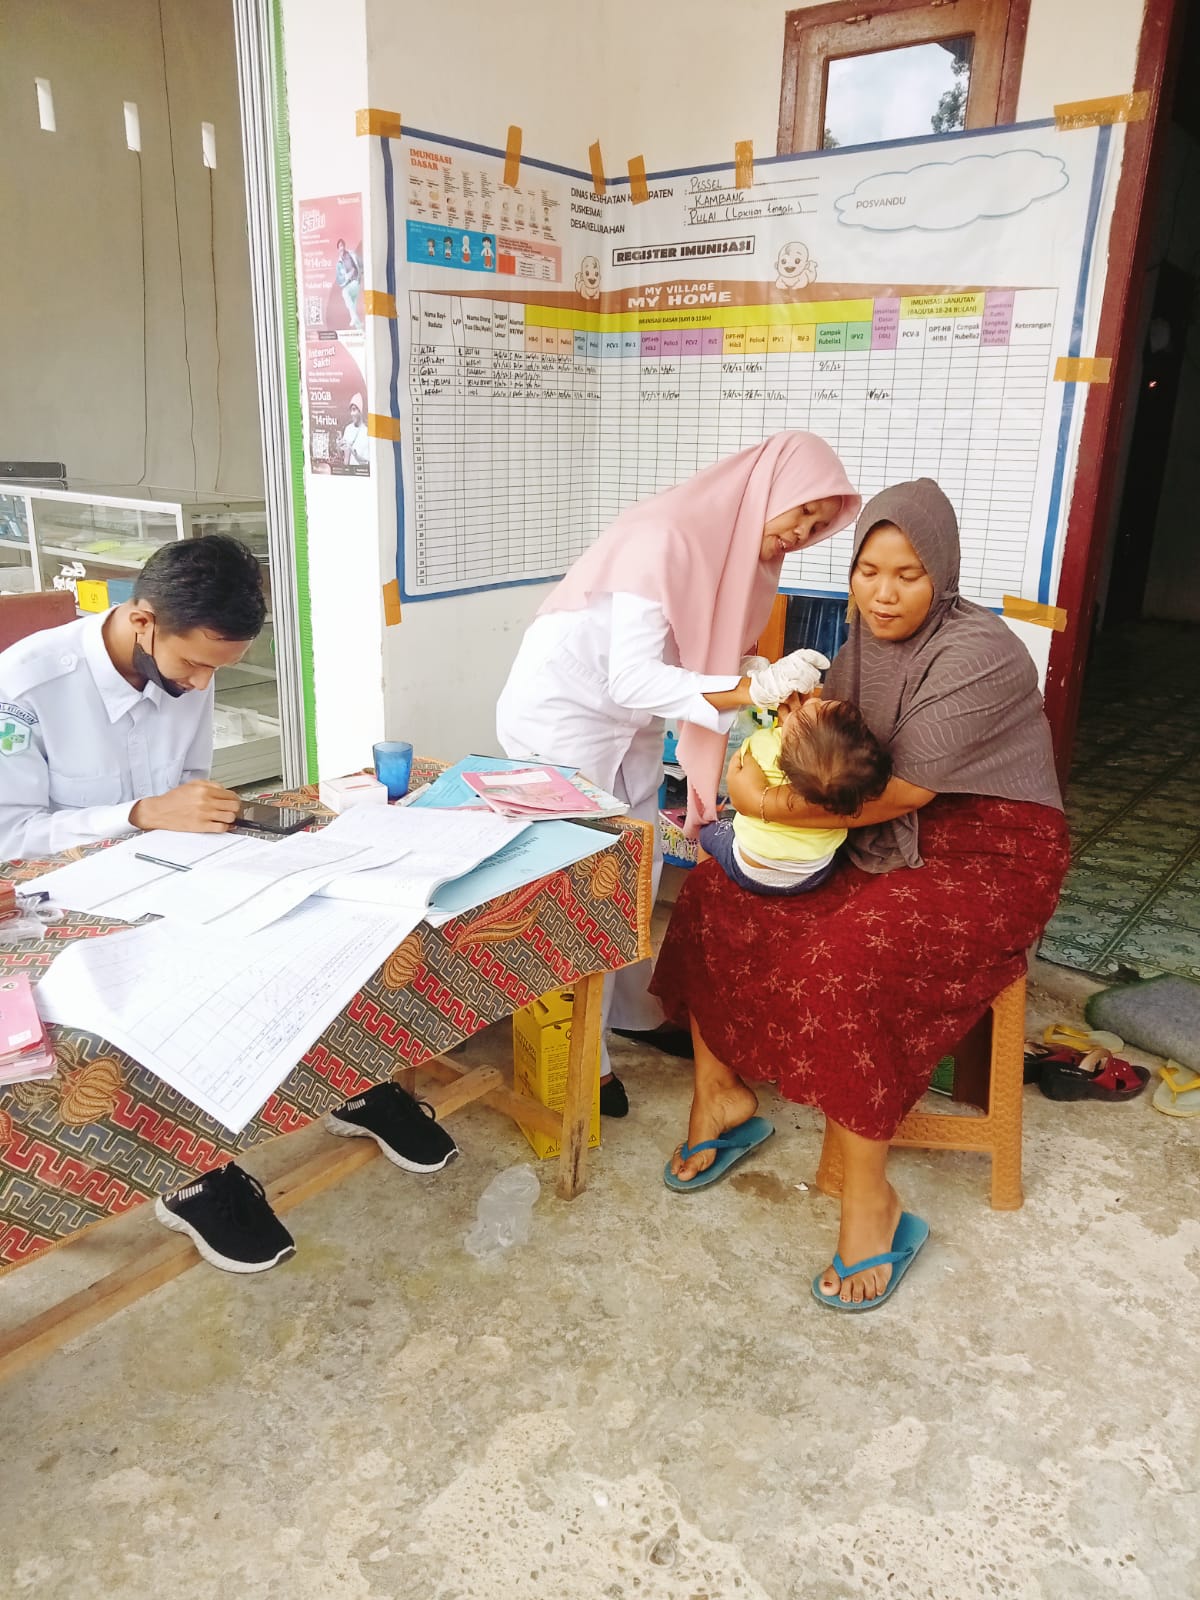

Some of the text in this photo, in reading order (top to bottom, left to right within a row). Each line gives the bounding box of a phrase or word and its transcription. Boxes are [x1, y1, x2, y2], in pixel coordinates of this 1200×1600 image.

[409, 148, 452, 165] IMUNISASI
[411, 158, 438, 171] DASAR
[571, 187, 588, 200] DINAS
[694, 191, 744, 207] KAMBANG
[616, 239, 751, 263] REGISTER IMUNISASI
[645, 282, 716, 296] MY VILLAGE
[627, 291, 732, 308] MY HOME
[910, 296, 976, 306] IMUNISASI LANJUTAN
[820, 328, 841, 336] Campak
[928, 325, 951, 333] DPT-HB
[1014, 321, 1052, 330] Keterangan
[308, 346, 336, 359] Internet
[313, 357, 331, 369] Sakti
